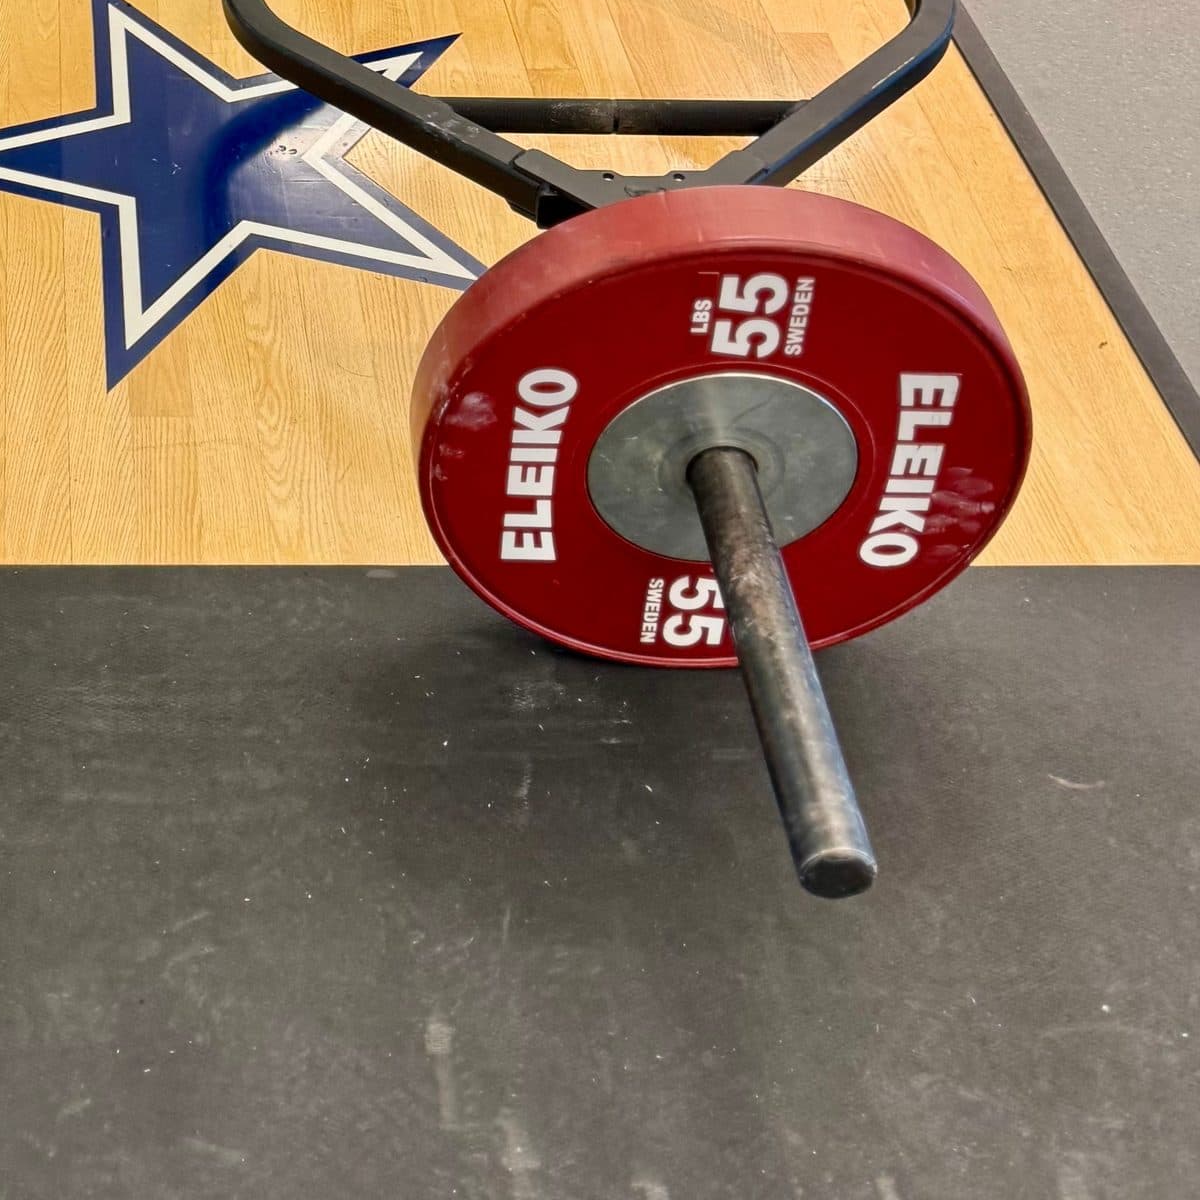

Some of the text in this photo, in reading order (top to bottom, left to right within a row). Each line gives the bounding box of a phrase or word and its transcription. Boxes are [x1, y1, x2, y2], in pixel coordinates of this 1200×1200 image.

[689, 298, 713, 334] LBS
[710, 272, 789, 359] 55
[783, 276, 816, 357] SWEDEN
[500, 367, 580, 561] ELEIKO
[858, 371, 963, 568] ELEIKO
[640, 578, 664, 643] SWEDEN
[663, 575, 725, 647] 55
